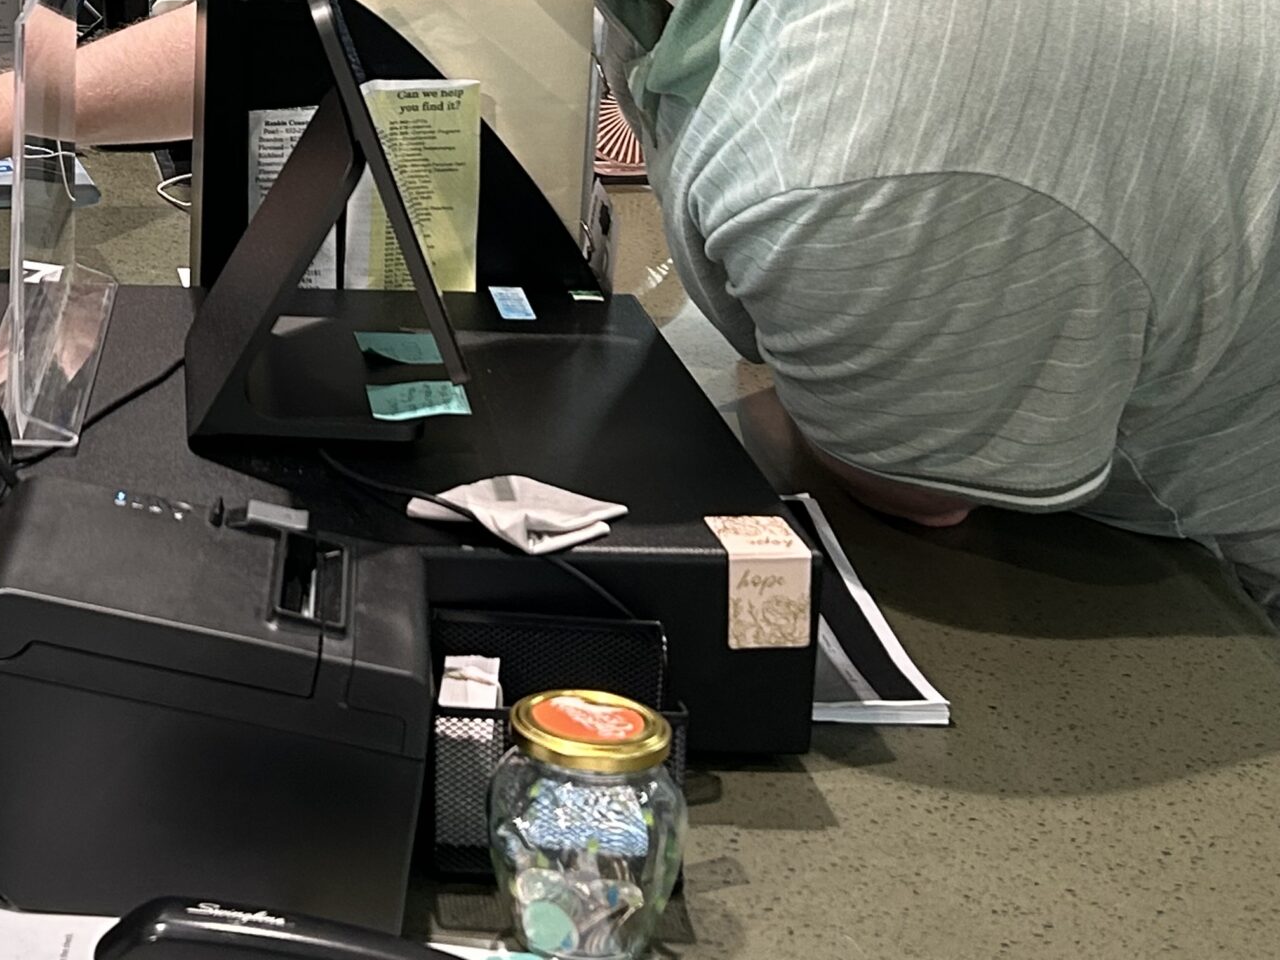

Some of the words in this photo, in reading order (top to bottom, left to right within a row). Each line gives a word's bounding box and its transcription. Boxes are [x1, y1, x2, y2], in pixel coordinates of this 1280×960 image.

[397, 91, 418, 100] Can
[422, 90, 438, 98] we
[440, 89, 464, 98] help
[399, 104, 419, 114] you
[422, 101, 444, 111] find
[447, 100, 462, 111] it?
[737, 569, 785, 596] hope
